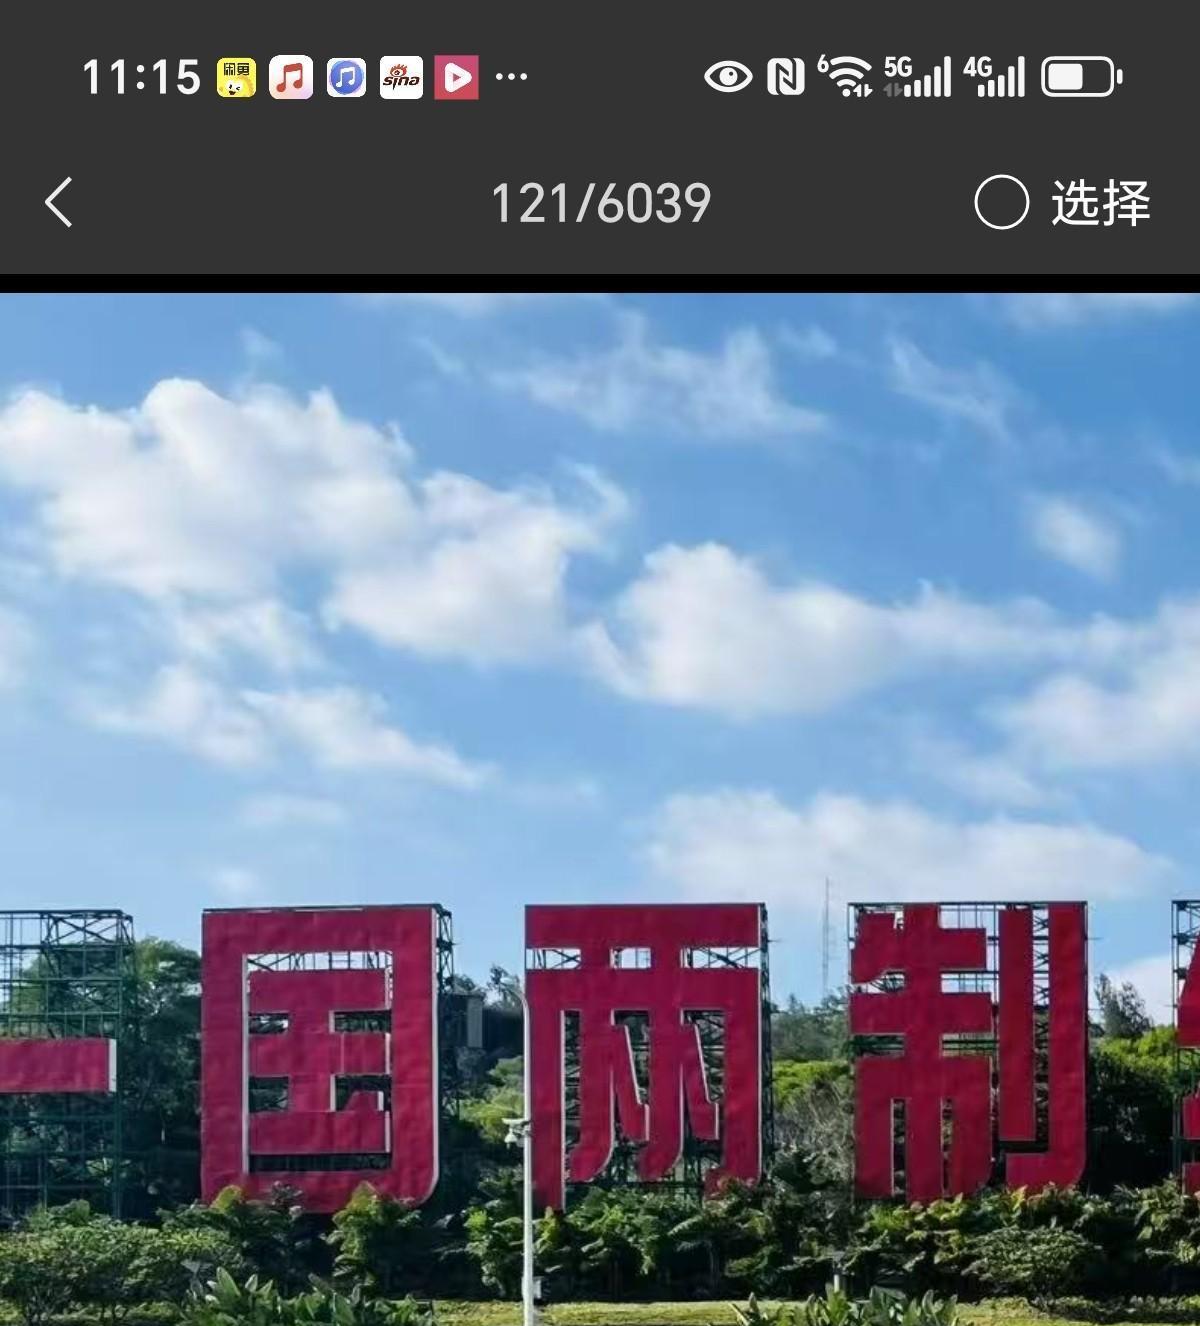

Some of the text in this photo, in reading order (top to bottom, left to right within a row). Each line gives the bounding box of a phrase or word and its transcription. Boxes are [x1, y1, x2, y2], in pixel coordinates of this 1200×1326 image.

[83, 58, 201, 95] 11:15
[817, 54, 829, 73] 6
[884, 56, 913, 78] 5G
[963, 56, 993, 78] 4G
[382, 76, 420, 91] sina
[493, 182, 711, 224] 121/6039
[1051, 178, 1151, 227] 选择
[0, 903, 1200, 1210] 一国两制
